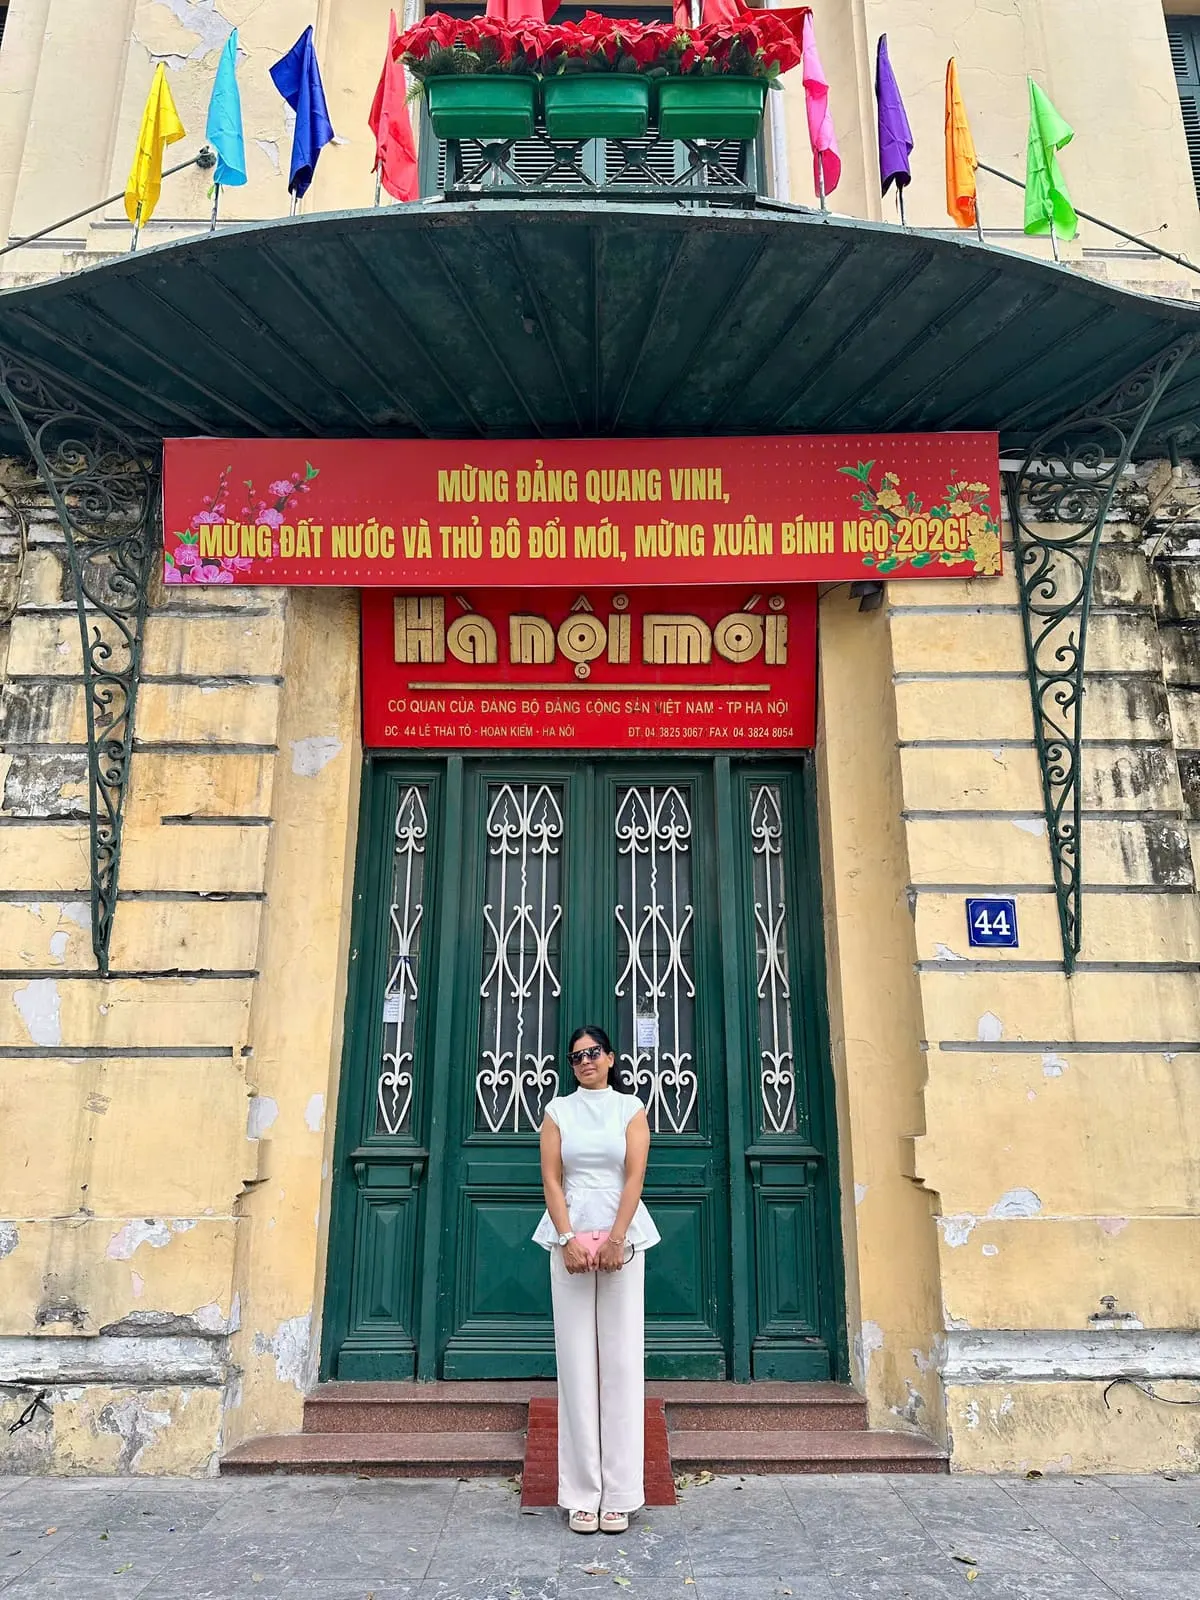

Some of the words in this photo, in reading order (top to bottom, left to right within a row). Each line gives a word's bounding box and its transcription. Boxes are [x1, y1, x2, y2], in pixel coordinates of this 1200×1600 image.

[437, 463, 509, 503] MỪNG
[516, 458, 579, 503] ĐẢNG
[585, 468, 662, 504] QUANG
[668, 467, 731, 504] VINH,
[199, 518, 273, 558] MỪNG
[279, 517, 324, 558] ĐẤT
[331, 516, 395, 559] NƯỚC
[401, 517, 433, 559] VÀ
[439, 515, 483, 559] THỦ
[489, 517, 521, 559] ĐÔ
[527, 516, 567, 559] ĐỔI
[573, 516, 628, 562] MỚI,
[634, 517, 705, 558] MỪNG
[712, 514, 773, 557] XUÂN
[780, 513, 835, 555] BÍNH
[842, 518, 889, 560] NGỌ
[895, 517, 968, 552] 2026!
[387, 698, 407, 713] CƠ
[409, 700, 446, 714] QUAN
[449, 696, 476, 713] CỦA
[480, 696, 517, 714] ĐẢNG
[521, 697, 540, 716] BỘ
[545, 696, 581, 714] ĐẢNG
[585, 697, 621, 717] CỘNG
[654, 698, 682, 717] VIỆT
[685, 701, 714, 714] NAM
[726, 701, 742, 714] TP
[767, 698, 789, 717] NỘI
[403, 725, 416, 737] 44
[418, 723, 431, 737] LÊ
[659, 727, 681, 738] 3825
[682, 727, 704, 738] 3067
[709, 727, 729, 738] FAX
[747, 727, 770, 738] 3824
[771, 727, 794, 738] 8054
[974, 909, 1011, 936] 44
